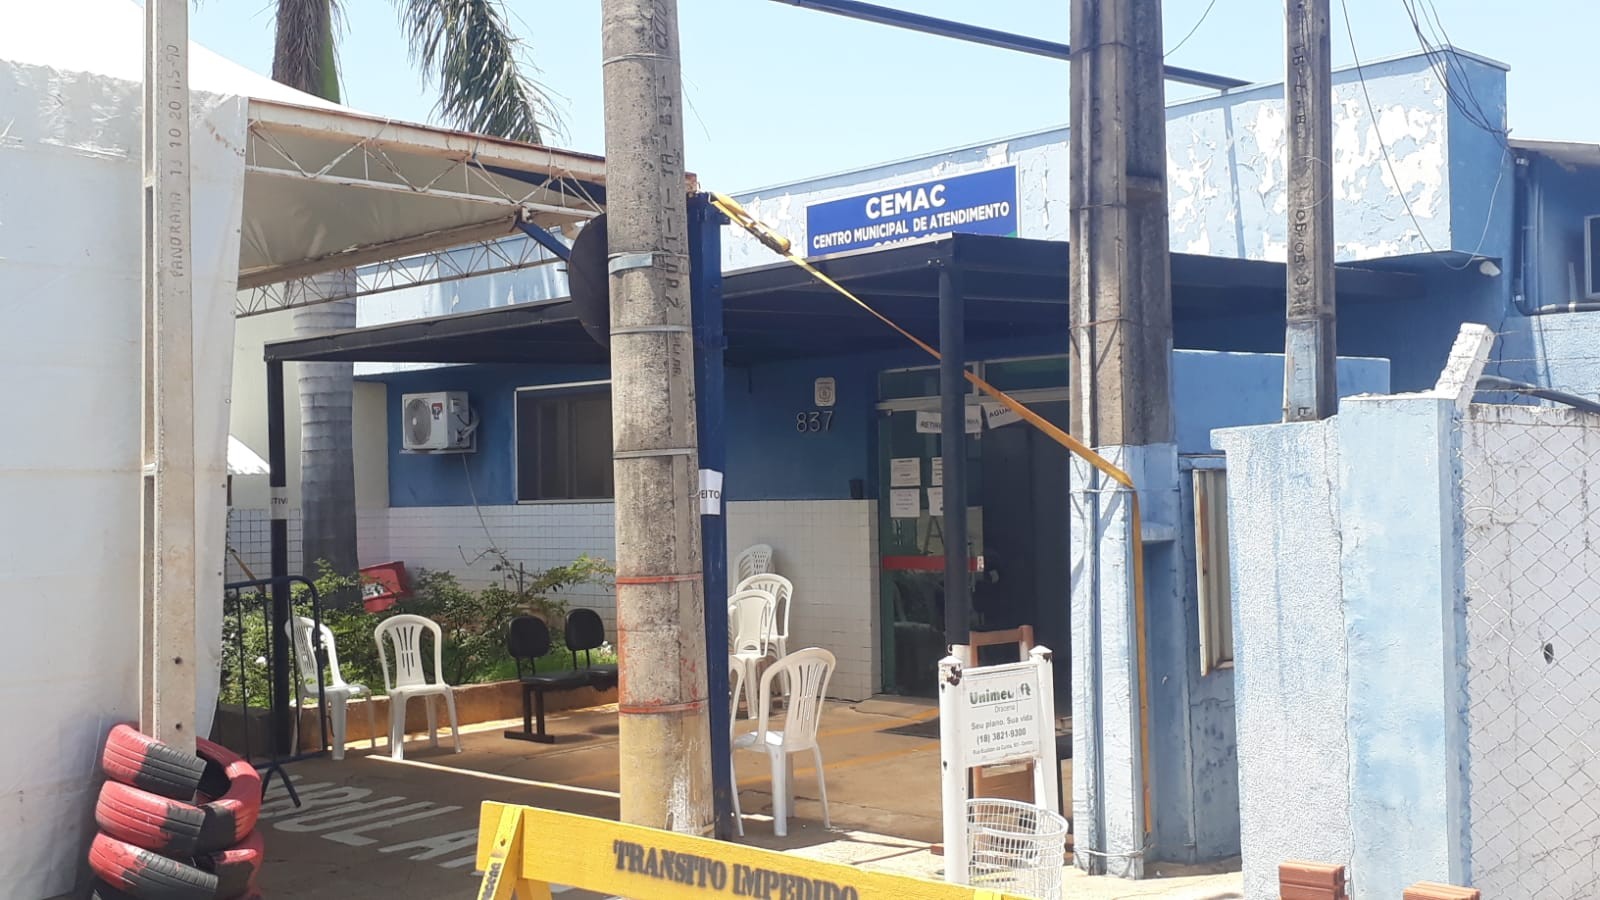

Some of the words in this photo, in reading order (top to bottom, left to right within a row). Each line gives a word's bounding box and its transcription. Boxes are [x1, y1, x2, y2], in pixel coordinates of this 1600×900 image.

[168, 100, 182, 120] 20
[168, 128, 182, 148] 10
[866, 184, 946, 219] CEMAC
[168, 191, 184, 278] PANORAMA
[813, 231, 852, 249] CENTRO
[854, 219, 909, 241] MUNICIPAL
[913, 216, 927, 232] DE
[930, 201, 1010, 230] ATENDIMENTO
[796, 410, 833, 432] 837
[971, 721, 984, 730] Seu
[1007, 716, 1019, 725] Sua
[1020, 714, 1033, 722] vida
[976, 734, 991, 745] (18)
[613, 839, 728, 891] TRANSITO
